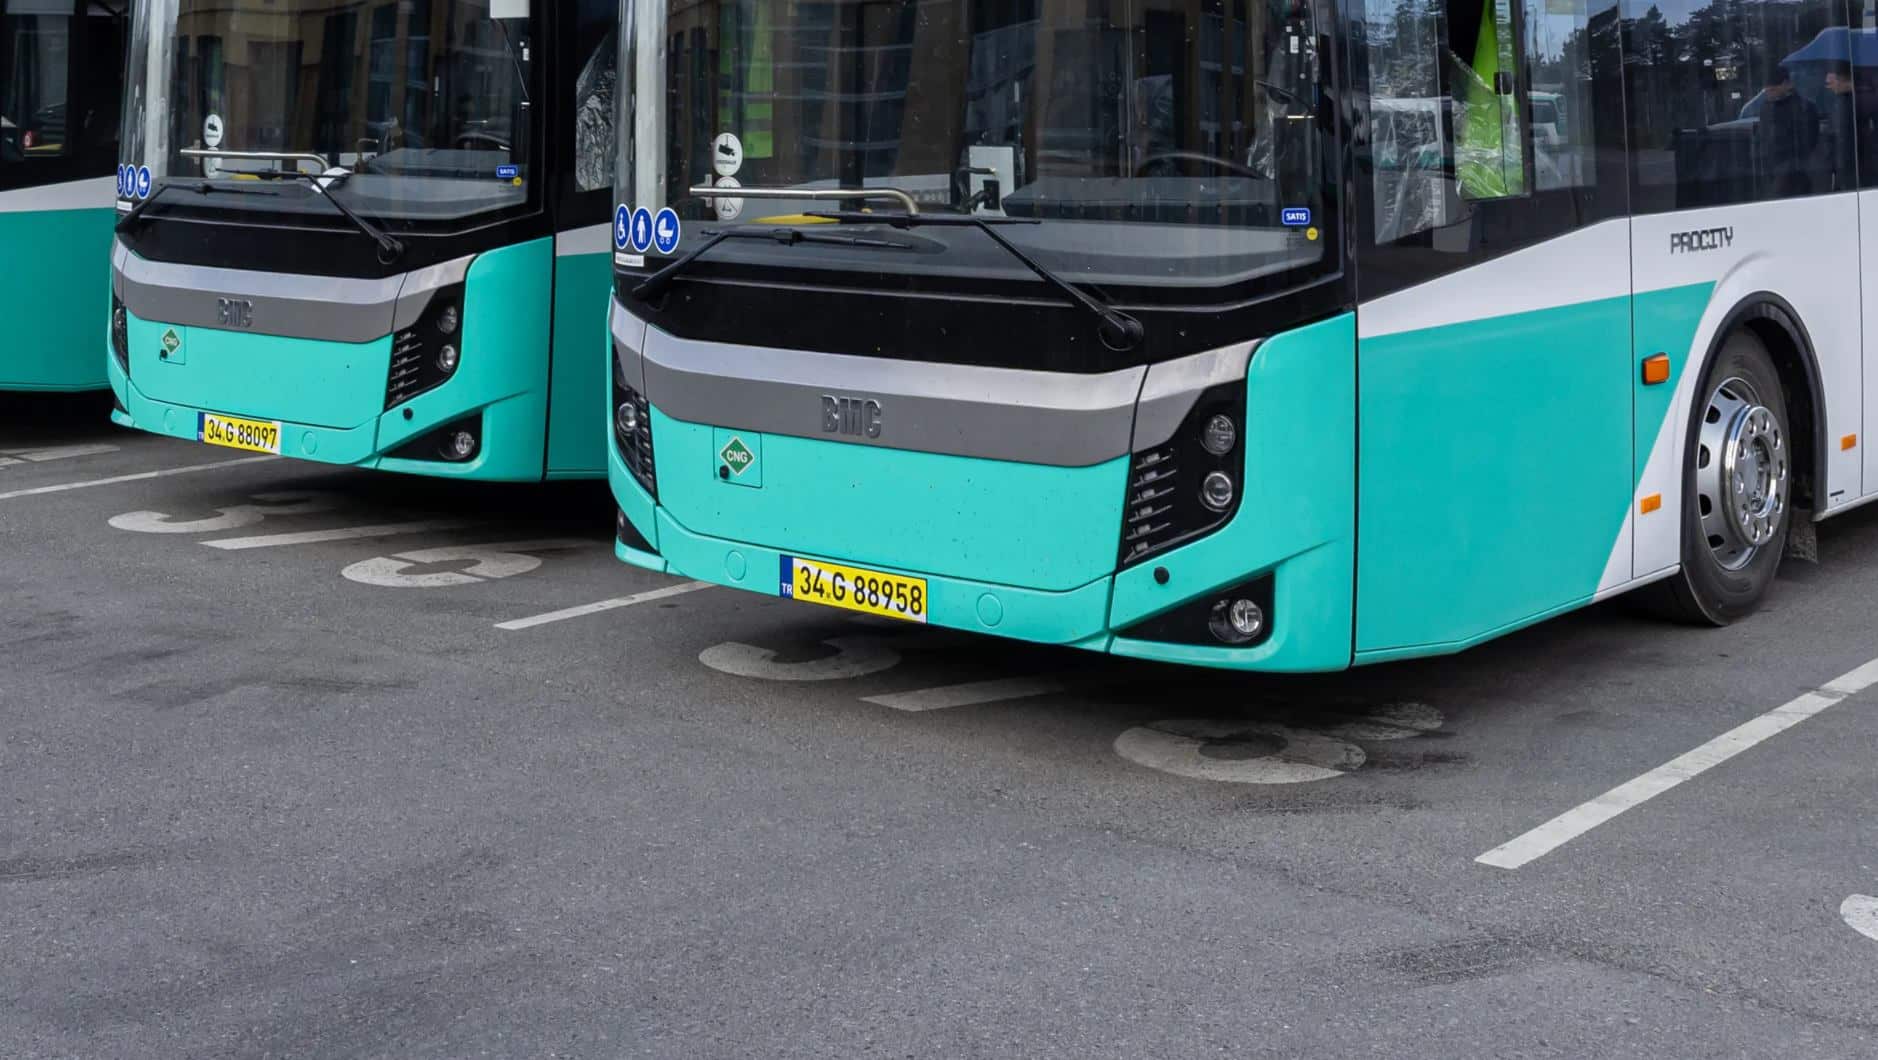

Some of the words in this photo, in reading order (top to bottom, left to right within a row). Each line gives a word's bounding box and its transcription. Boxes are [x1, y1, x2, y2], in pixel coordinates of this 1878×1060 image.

[1670, 226, 1733, 255] PROCITY
[820, 394, 882, 439] BMC
[237, 423, 277, 449] 88097
[726, 450, 748, 464] CNG
[853, 575, 923, 616] 88958
